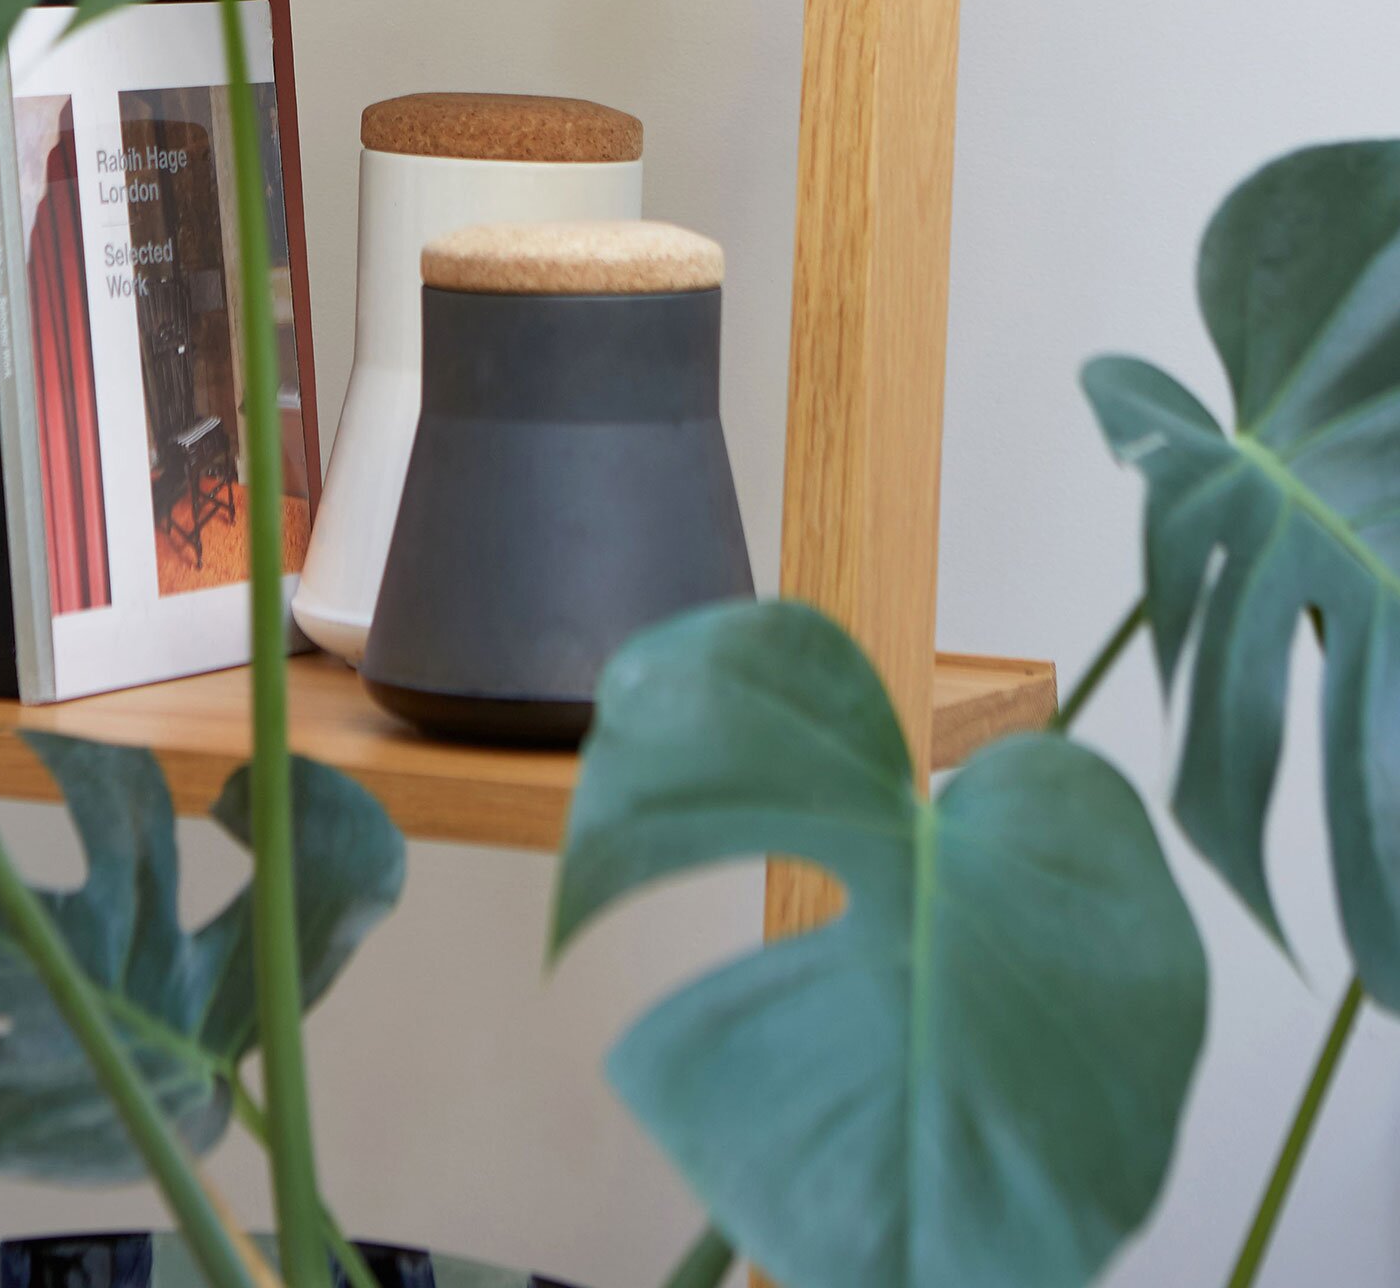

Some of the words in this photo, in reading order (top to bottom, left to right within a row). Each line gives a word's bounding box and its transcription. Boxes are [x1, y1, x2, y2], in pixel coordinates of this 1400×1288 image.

[96, 146, 142, 175] Rabih
[146, 144, 188, 174] Hage
[98, 178, 160, 206] London
[104, 238, 174, 267] Selected
[106, 273, 149, 299] Work
